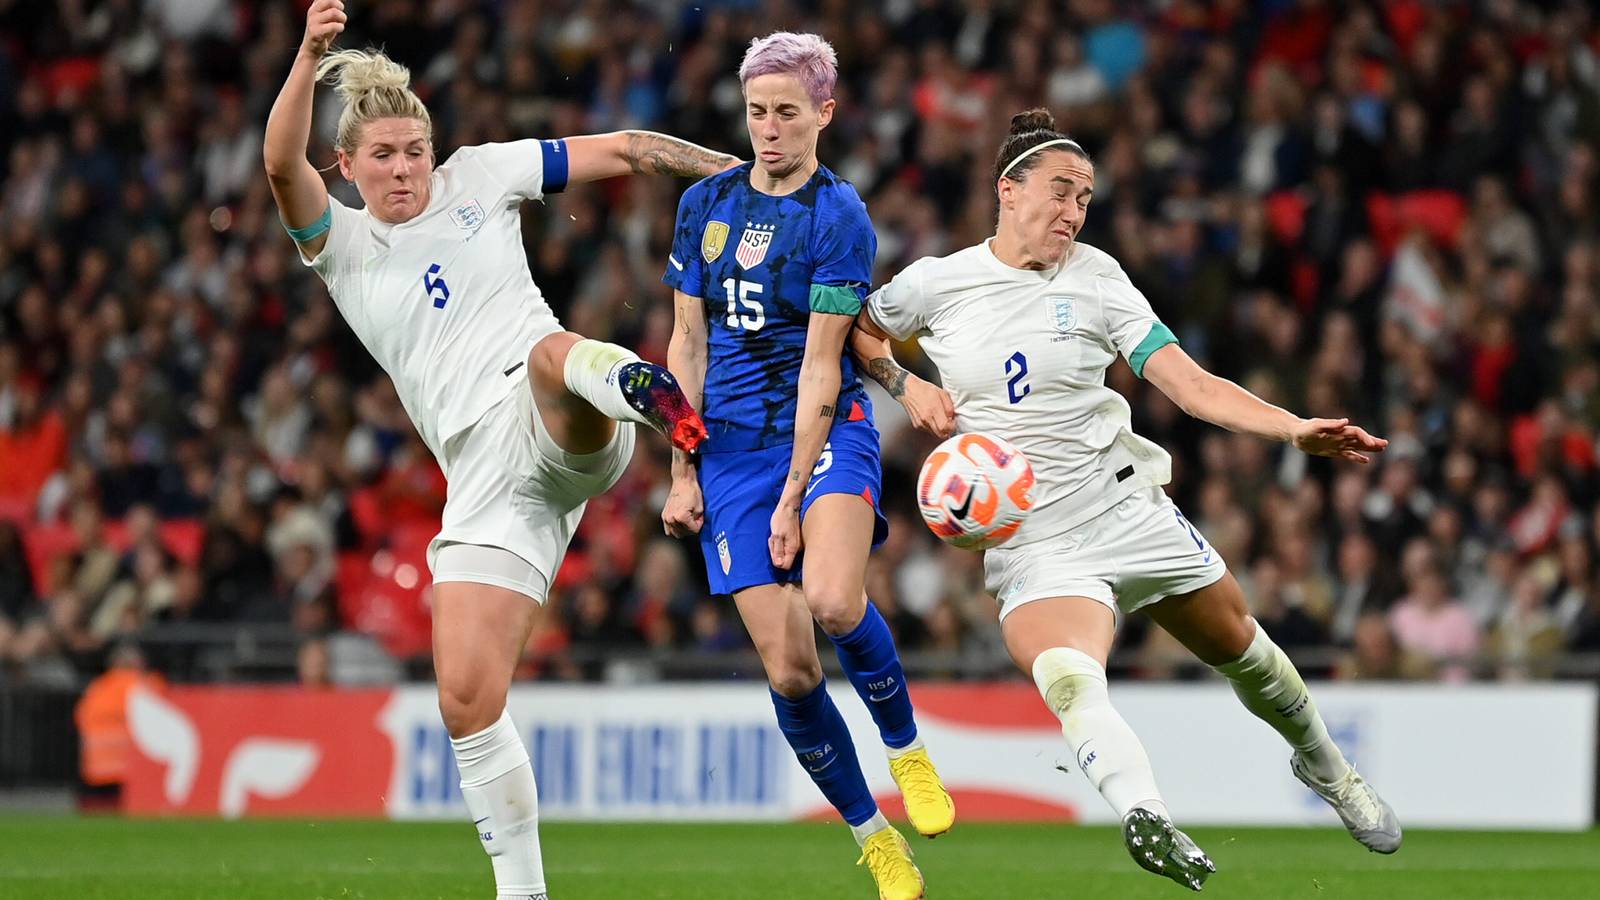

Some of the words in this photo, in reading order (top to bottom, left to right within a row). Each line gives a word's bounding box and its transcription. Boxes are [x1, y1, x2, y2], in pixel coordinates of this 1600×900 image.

[744, 231, 770, 248] USA
[423, 262, 450, 309] 5
[722, 277, 765, 331] 15
[1004, 351, 1031, 404] 2
[868, 676, 895, 691] USA
[805, 743, 833, 761] USA
